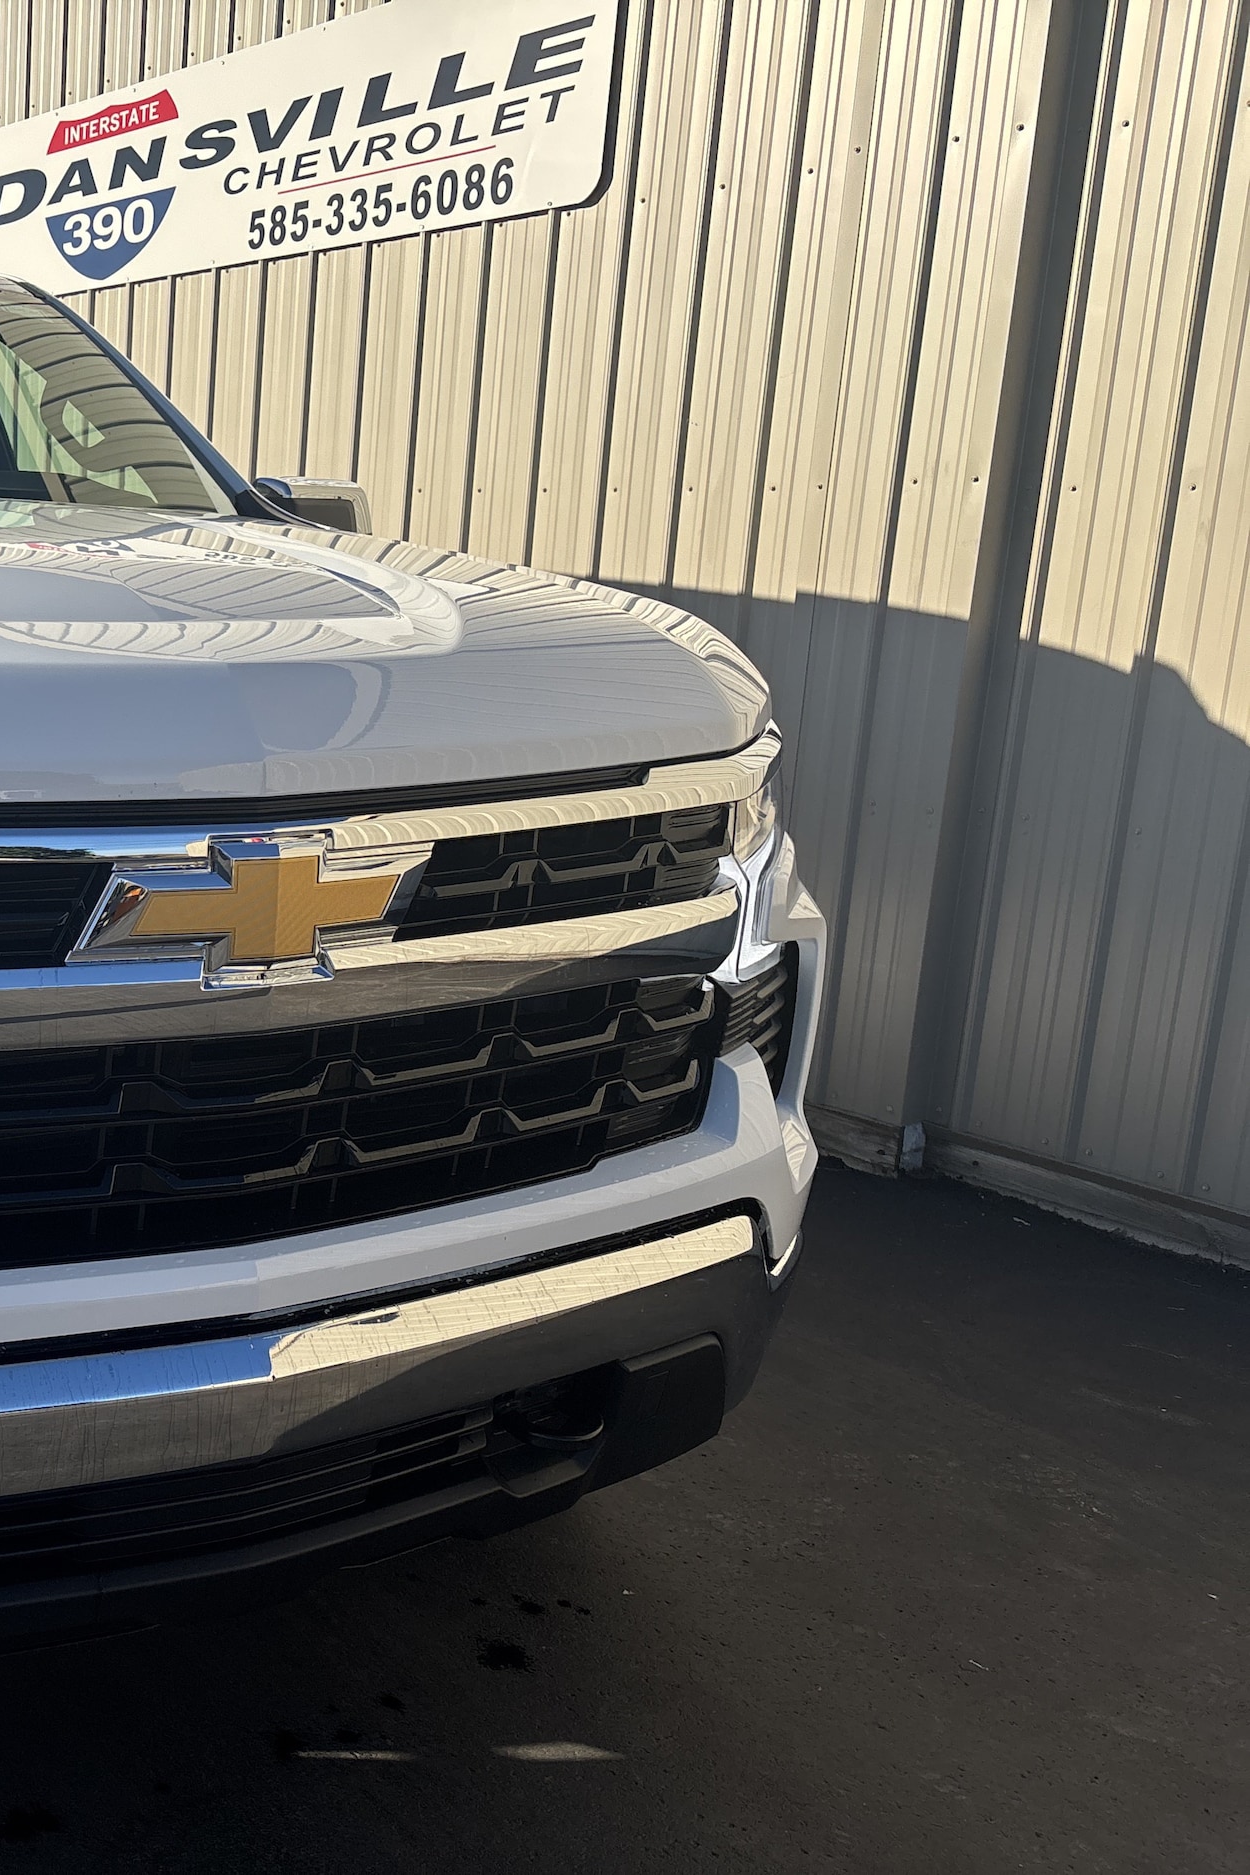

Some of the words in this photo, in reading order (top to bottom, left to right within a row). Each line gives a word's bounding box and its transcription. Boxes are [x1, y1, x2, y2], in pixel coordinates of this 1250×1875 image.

[63, 101, 160, 146] INTERSTATE
[223, 85, 576, 195] CHEVROLET
[61, 199, 154, 256] 390
[248, 157, 514, 250] 585-335-6086
